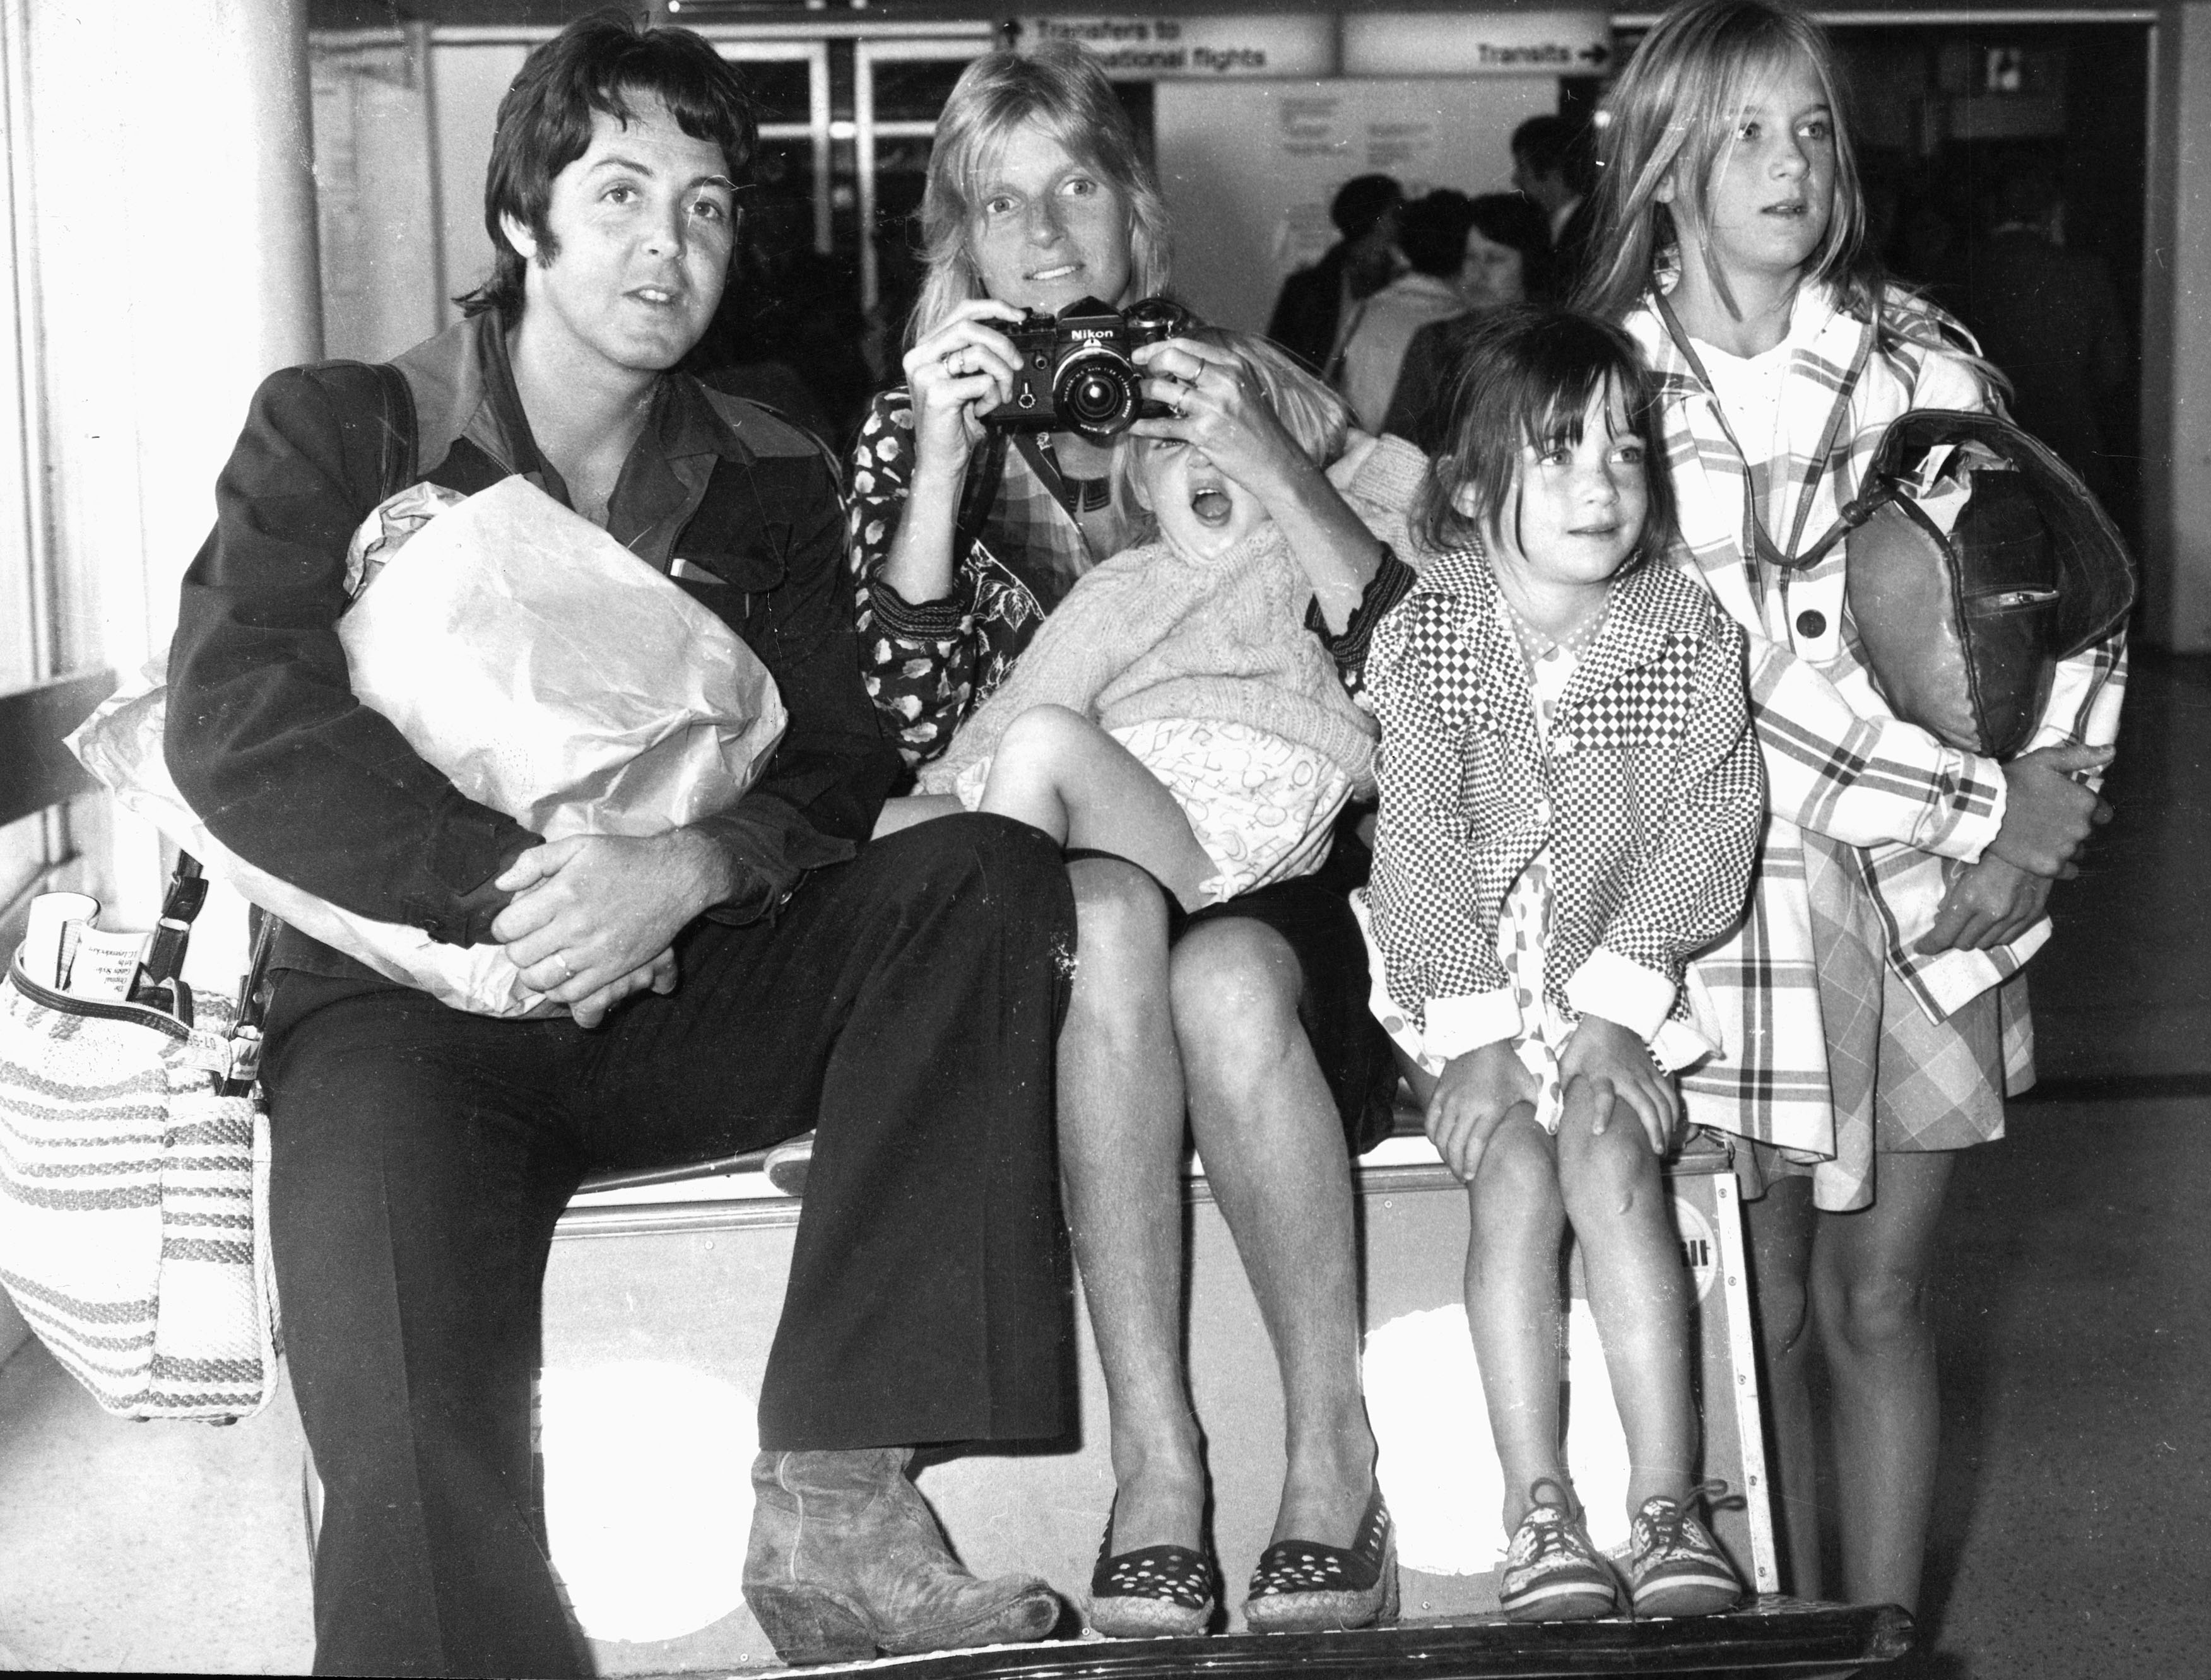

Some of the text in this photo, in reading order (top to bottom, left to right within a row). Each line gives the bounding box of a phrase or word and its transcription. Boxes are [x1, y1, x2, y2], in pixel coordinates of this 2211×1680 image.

[1038, 20, 1181, 39] Transfers to
[1194, 47, 1266, 73] flights
[1478, 44, 1570, 62] Transits
[1071, 329, 1114, 341] Nikon
